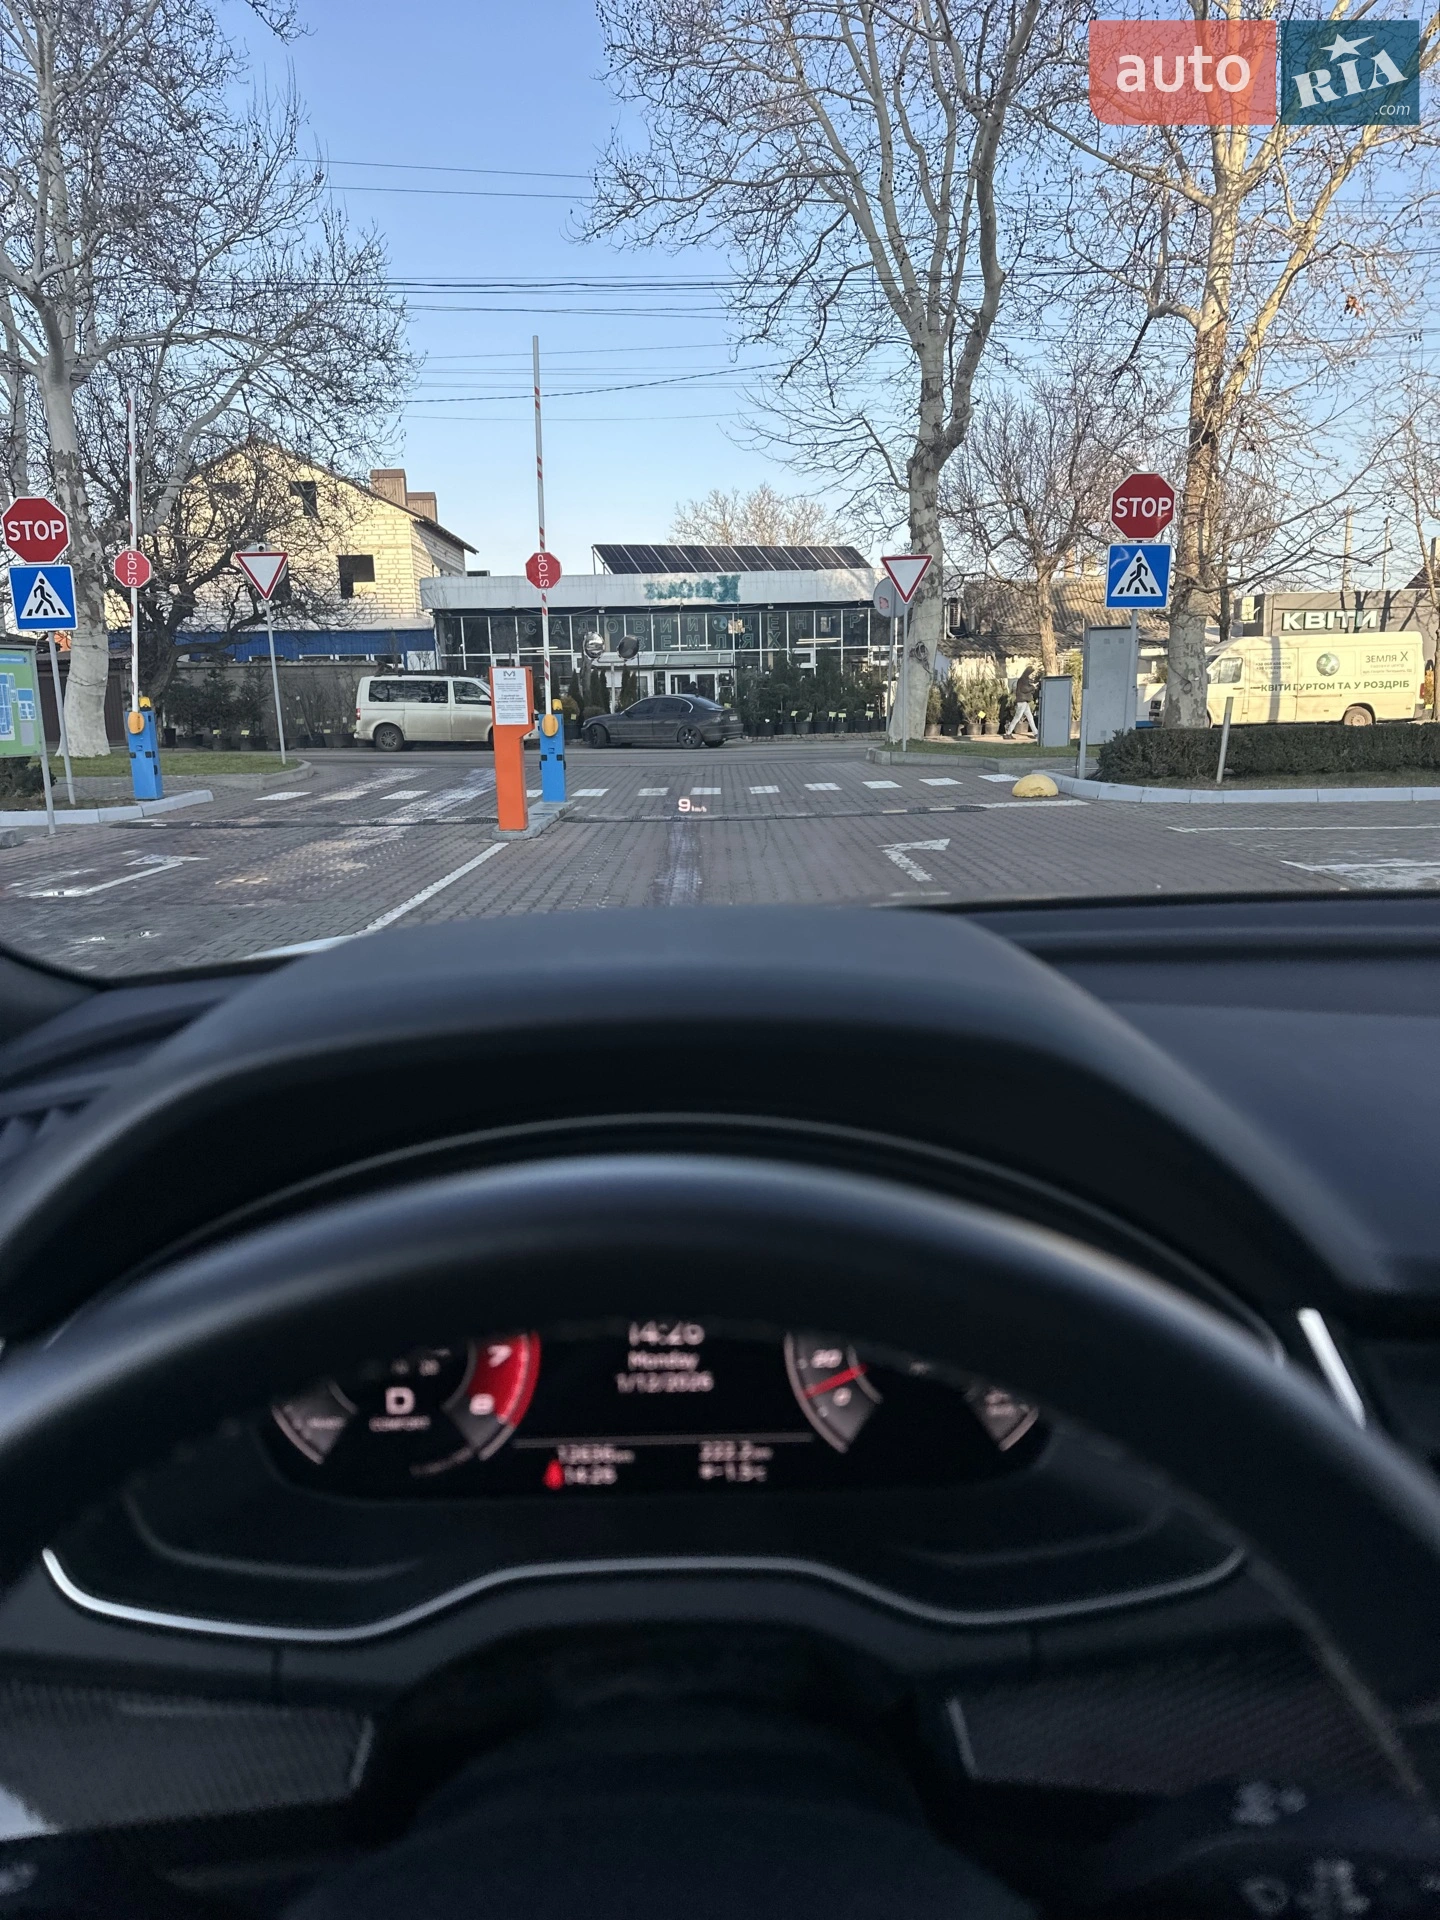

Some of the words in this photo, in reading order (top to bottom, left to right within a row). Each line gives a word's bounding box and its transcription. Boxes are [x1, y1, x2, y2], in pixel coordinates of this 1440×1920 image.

[1114, 496, 1172, 518] STOP
[7, 520, 65, 541] STOP
[127, 552, 138, 585] STOP
[537, 554, 550, 587] STOP
[742, 613, 861, 632] ЦЕНР
[1281, 611, 1378, 631] КВІТИ
[1366, 655, 1397, 663] ЗЕМЛЯ
[1261, 684, 1291, 692] КВІТИ
[1293, 682, 1335, 691] ГУРТОМ
[1354, 682, 1361, 690] У
[1364, 681, 1409, 689] РОЗДРІБ
[678, 798, 691, 812] 9
